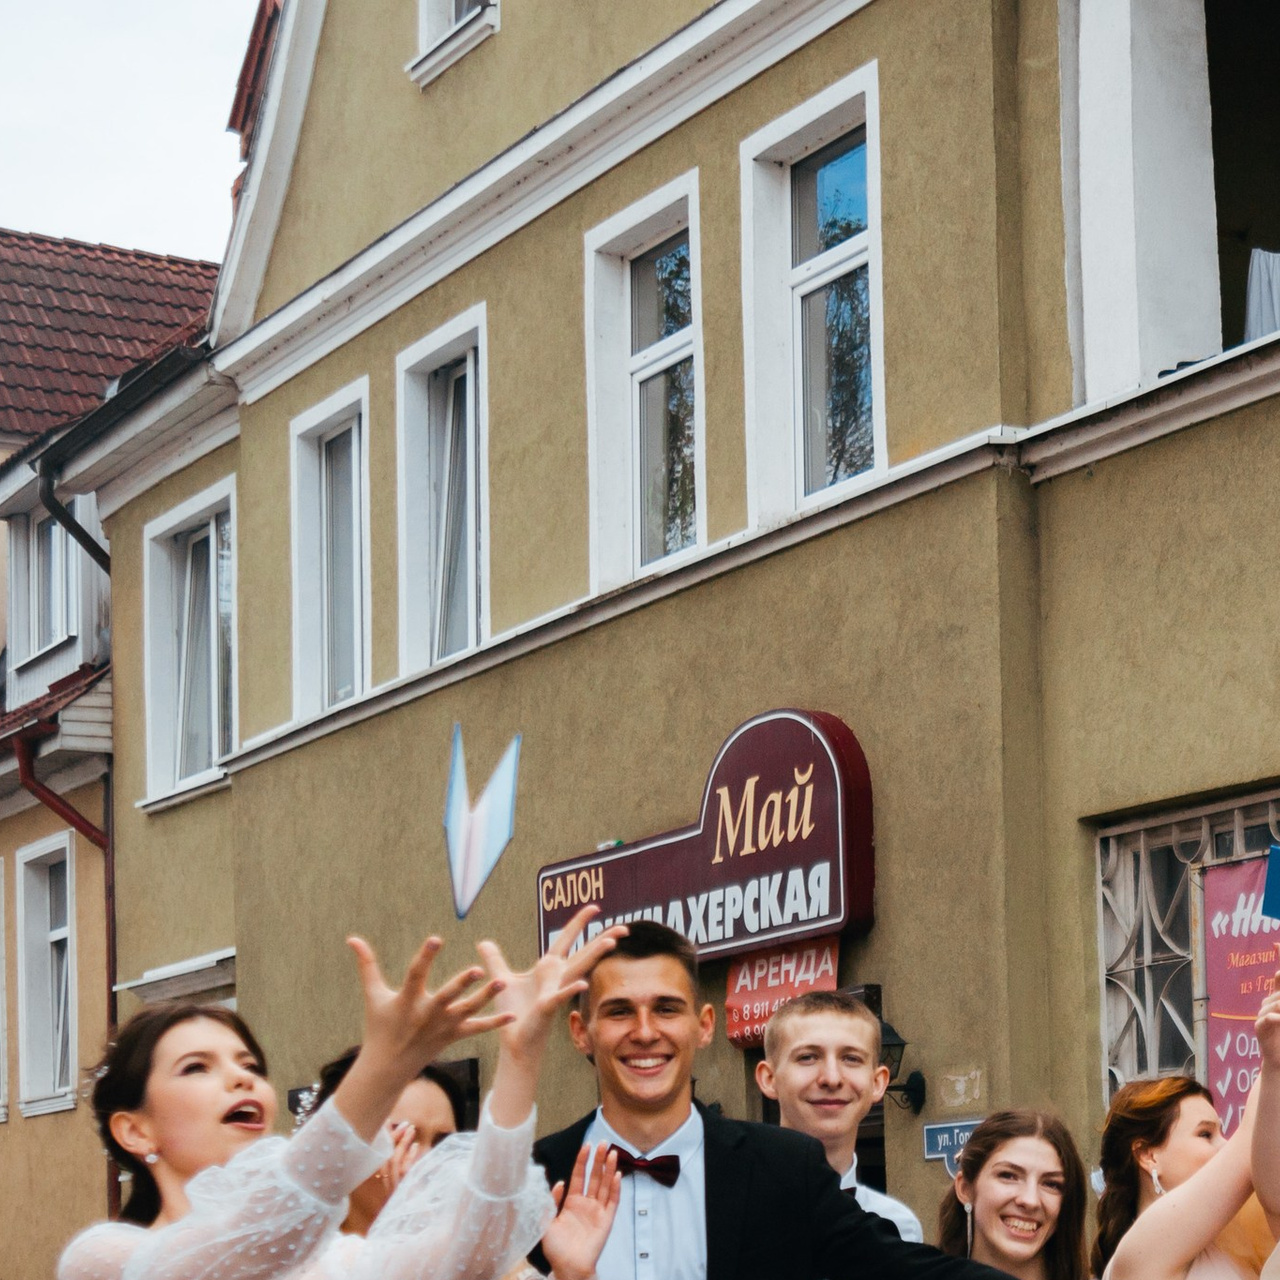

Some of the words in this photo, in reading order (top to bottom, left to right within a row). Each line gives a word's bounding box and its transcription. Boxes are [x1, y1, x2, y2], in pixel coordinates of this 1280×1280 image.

[711, 763, 815, 865] Май
[542, 867, 604, 911] САЛОН
[548, 861, 830, 957] АХЕРСКАЯ
[734, 946, 834, 994] АРЕНДА
[1227, 950, 1276, 970] Магазин
[1240, 981, 1253, 995] из
[742, 1004, 750, 1021] 8
[753, 1001, 769, 1020] 911
[937, 1134, 952, 1151] ул.
